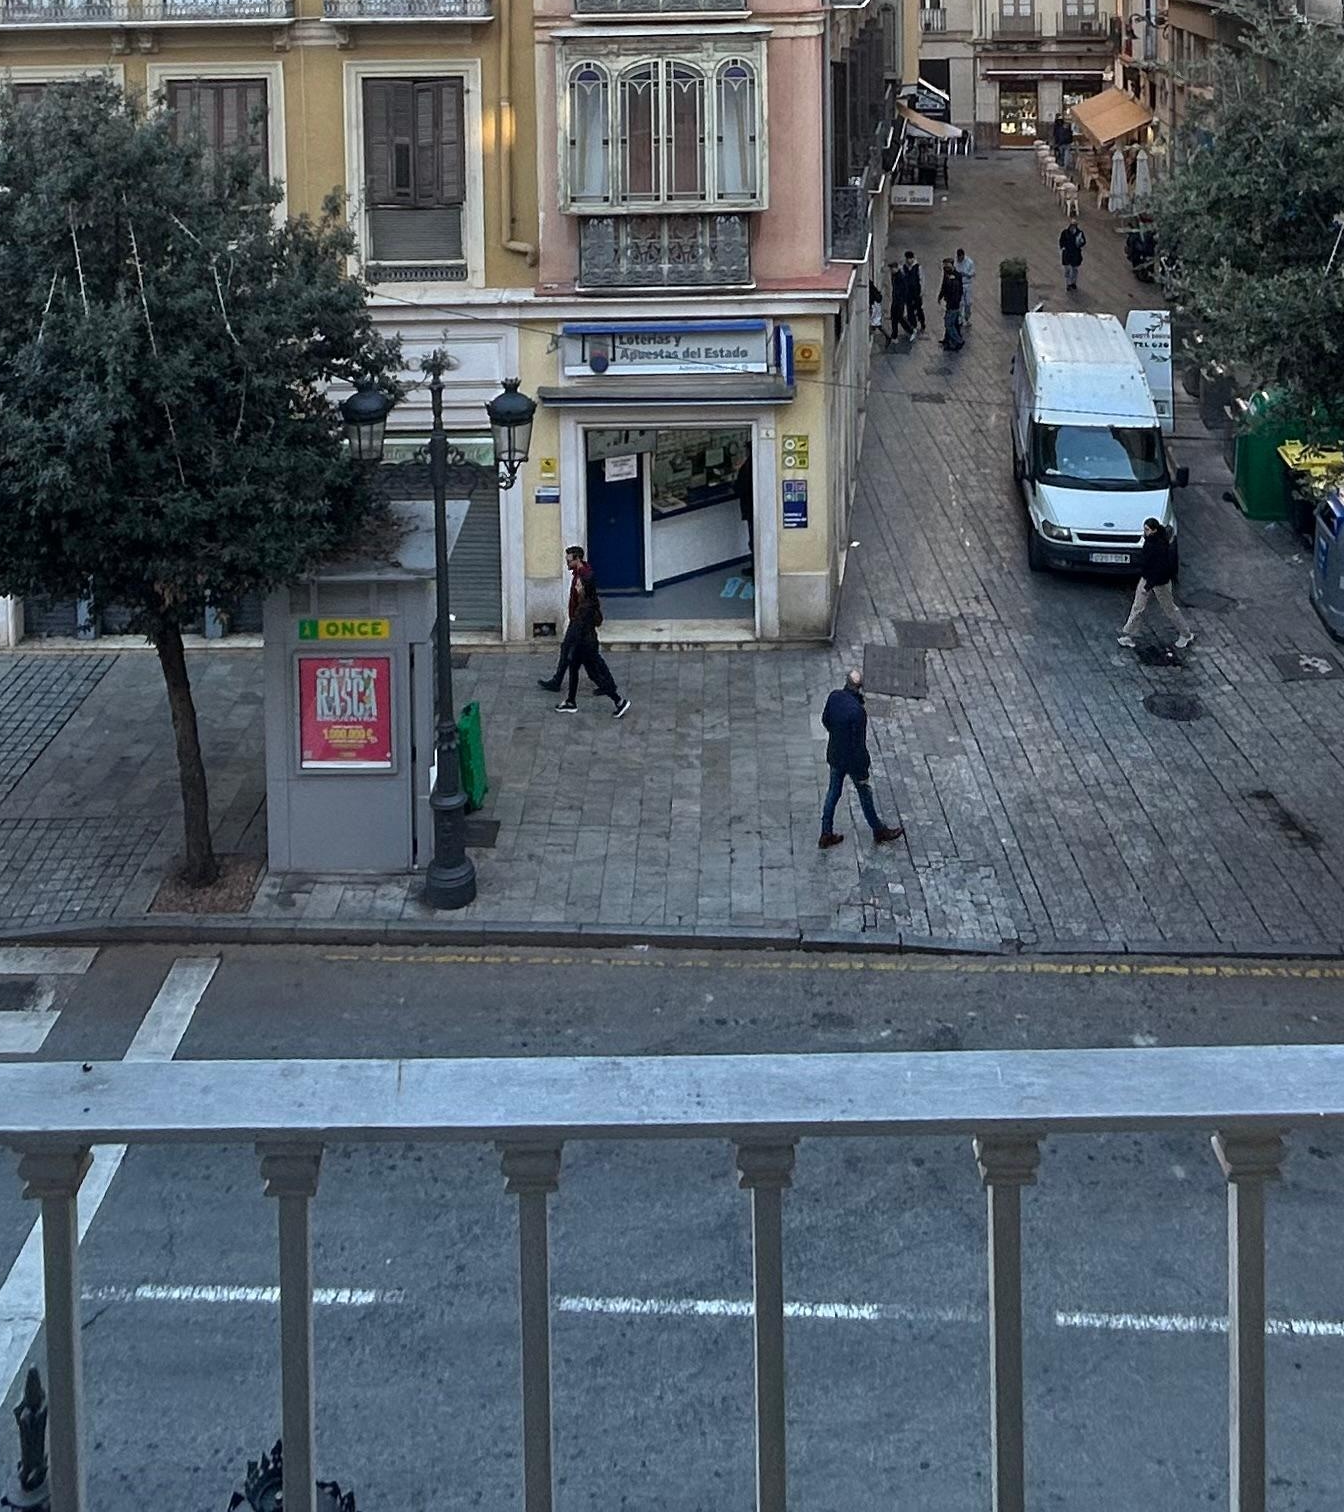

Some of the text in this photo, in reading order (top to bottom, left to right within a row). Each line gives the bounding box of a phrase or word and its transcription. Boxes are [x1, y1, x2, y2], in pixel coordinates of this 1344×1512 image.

[620, 346, 749, 361] Apuestas del Estado
[325, 621, 383, 636] ONCE
[315, 667, 378, 680] QUIEN
[315, 677, 379, 718] RASCA
